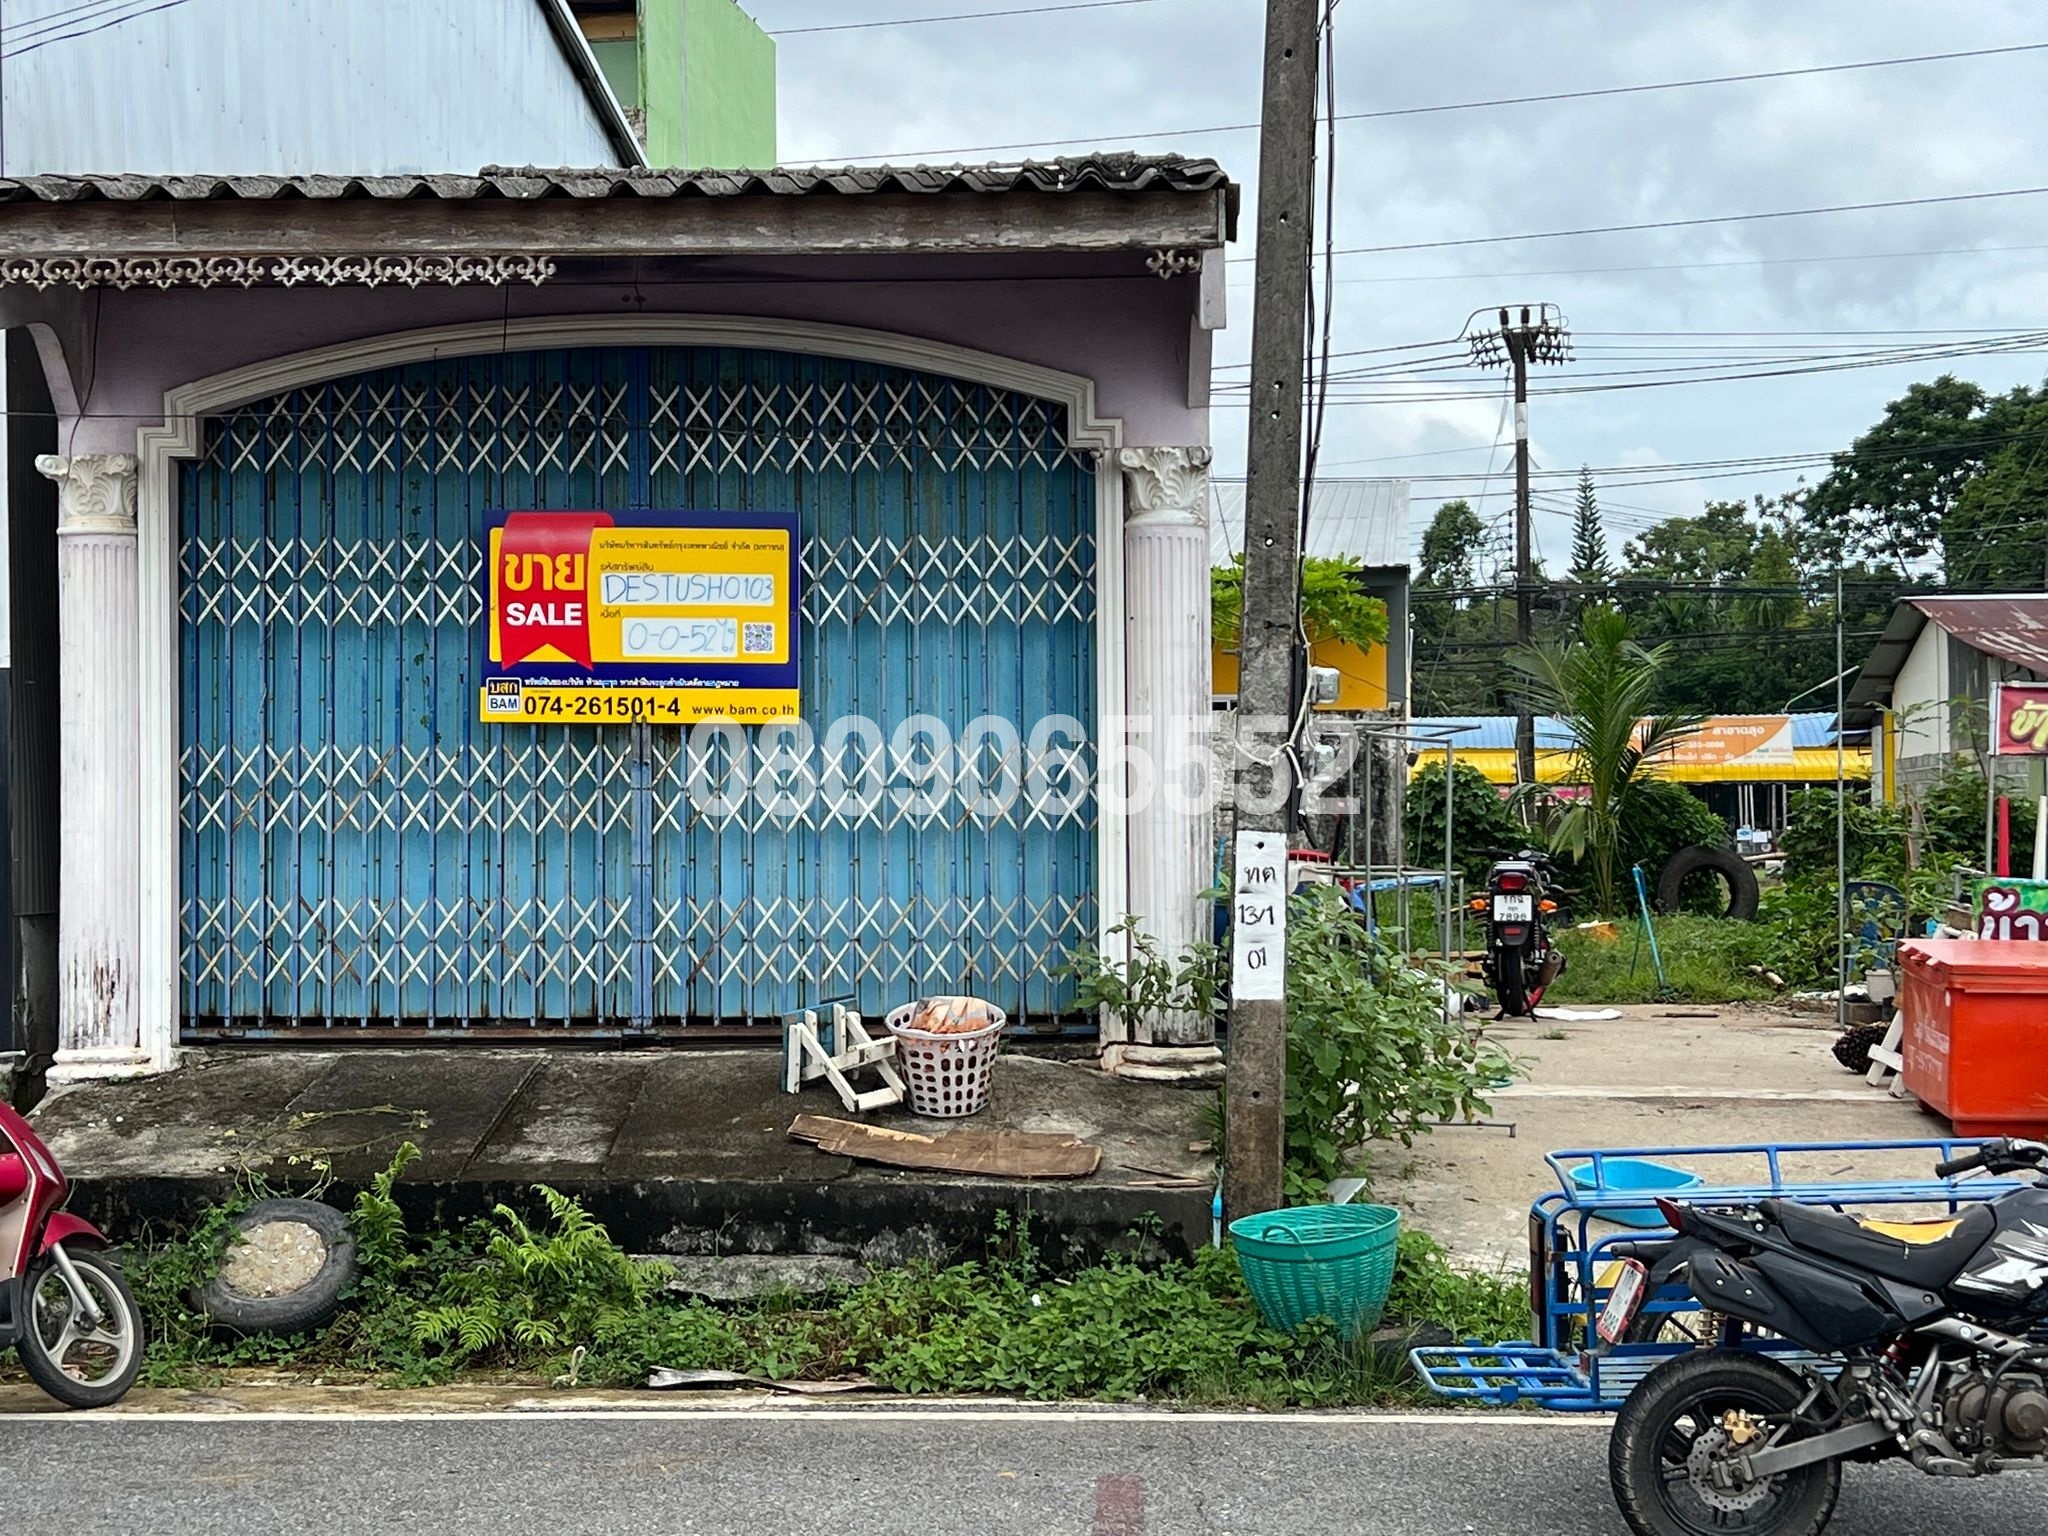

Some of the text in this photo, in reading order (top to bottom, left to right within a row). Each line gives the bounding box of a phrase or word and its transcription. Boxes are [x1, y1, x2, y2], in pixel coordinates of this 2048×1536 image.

[505, 553, 584, 591] ขาย
[506, 602, 582, 626] SALE
[490, 681, 518, 694] บสก
[490, 698, 517, 709] BAM
[524, 696, 794, 716] 074-261501-4 www.bam.co.th
[1247, 947, 1267, 969] 01
